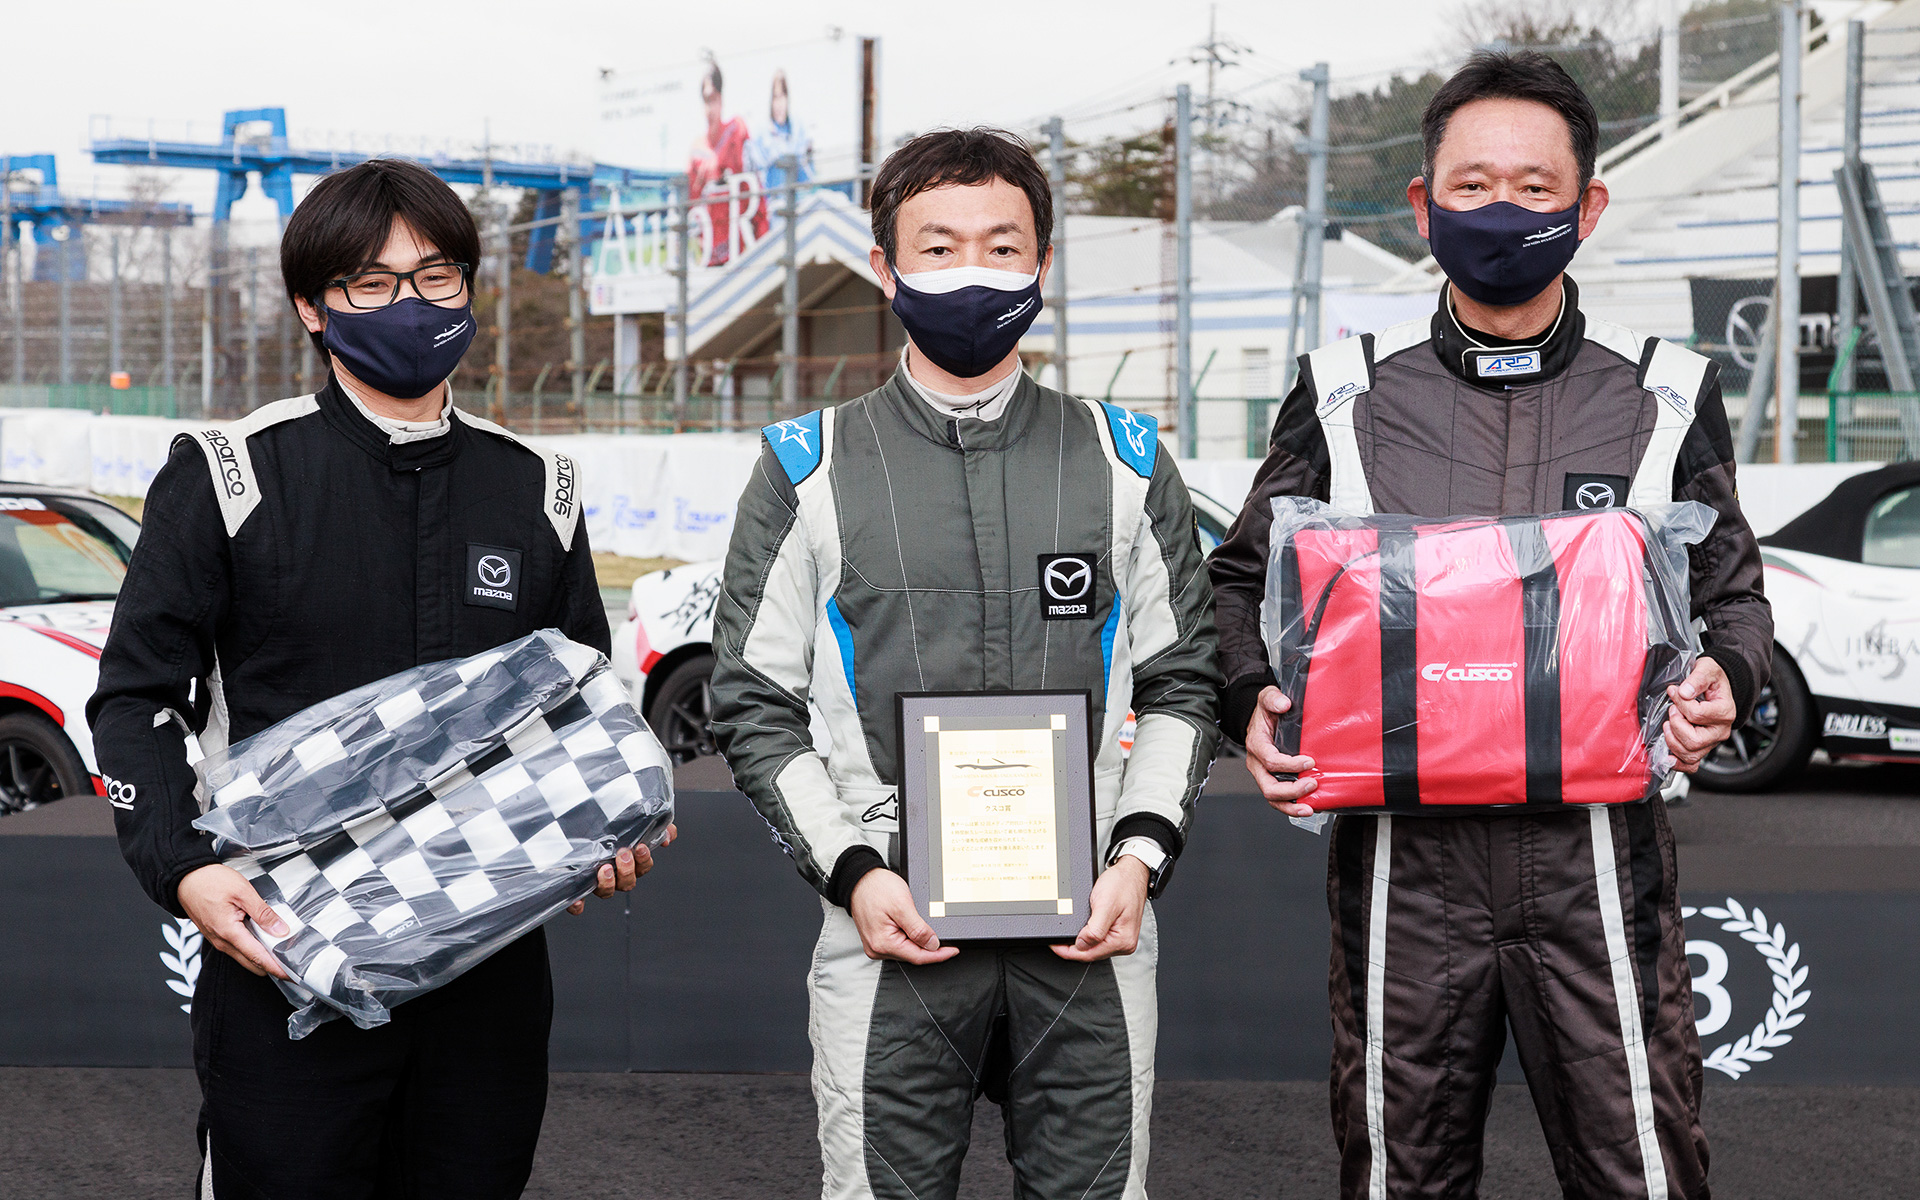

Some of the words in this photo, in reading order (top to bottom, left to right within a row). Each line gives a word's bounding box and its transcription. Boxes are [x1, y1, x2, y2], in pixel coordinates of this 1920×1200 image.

[1486, 355, 1533, 370] ARD
[1326, 382, 1356, 404] ARD
[204, 429, 246, 498] sparco
[553, 453, 573, 517] sparco
[473, 586, 513, 601] mazda
[1048, 604, 1088, 616] mazda
[1446, 668, 1513, 682] CUSCO
[1823, 712, 1888, 736] ENDLESS
[983, 788, 1026, 798] CUSCO
[1684, 939, 1732, 1037] 3
